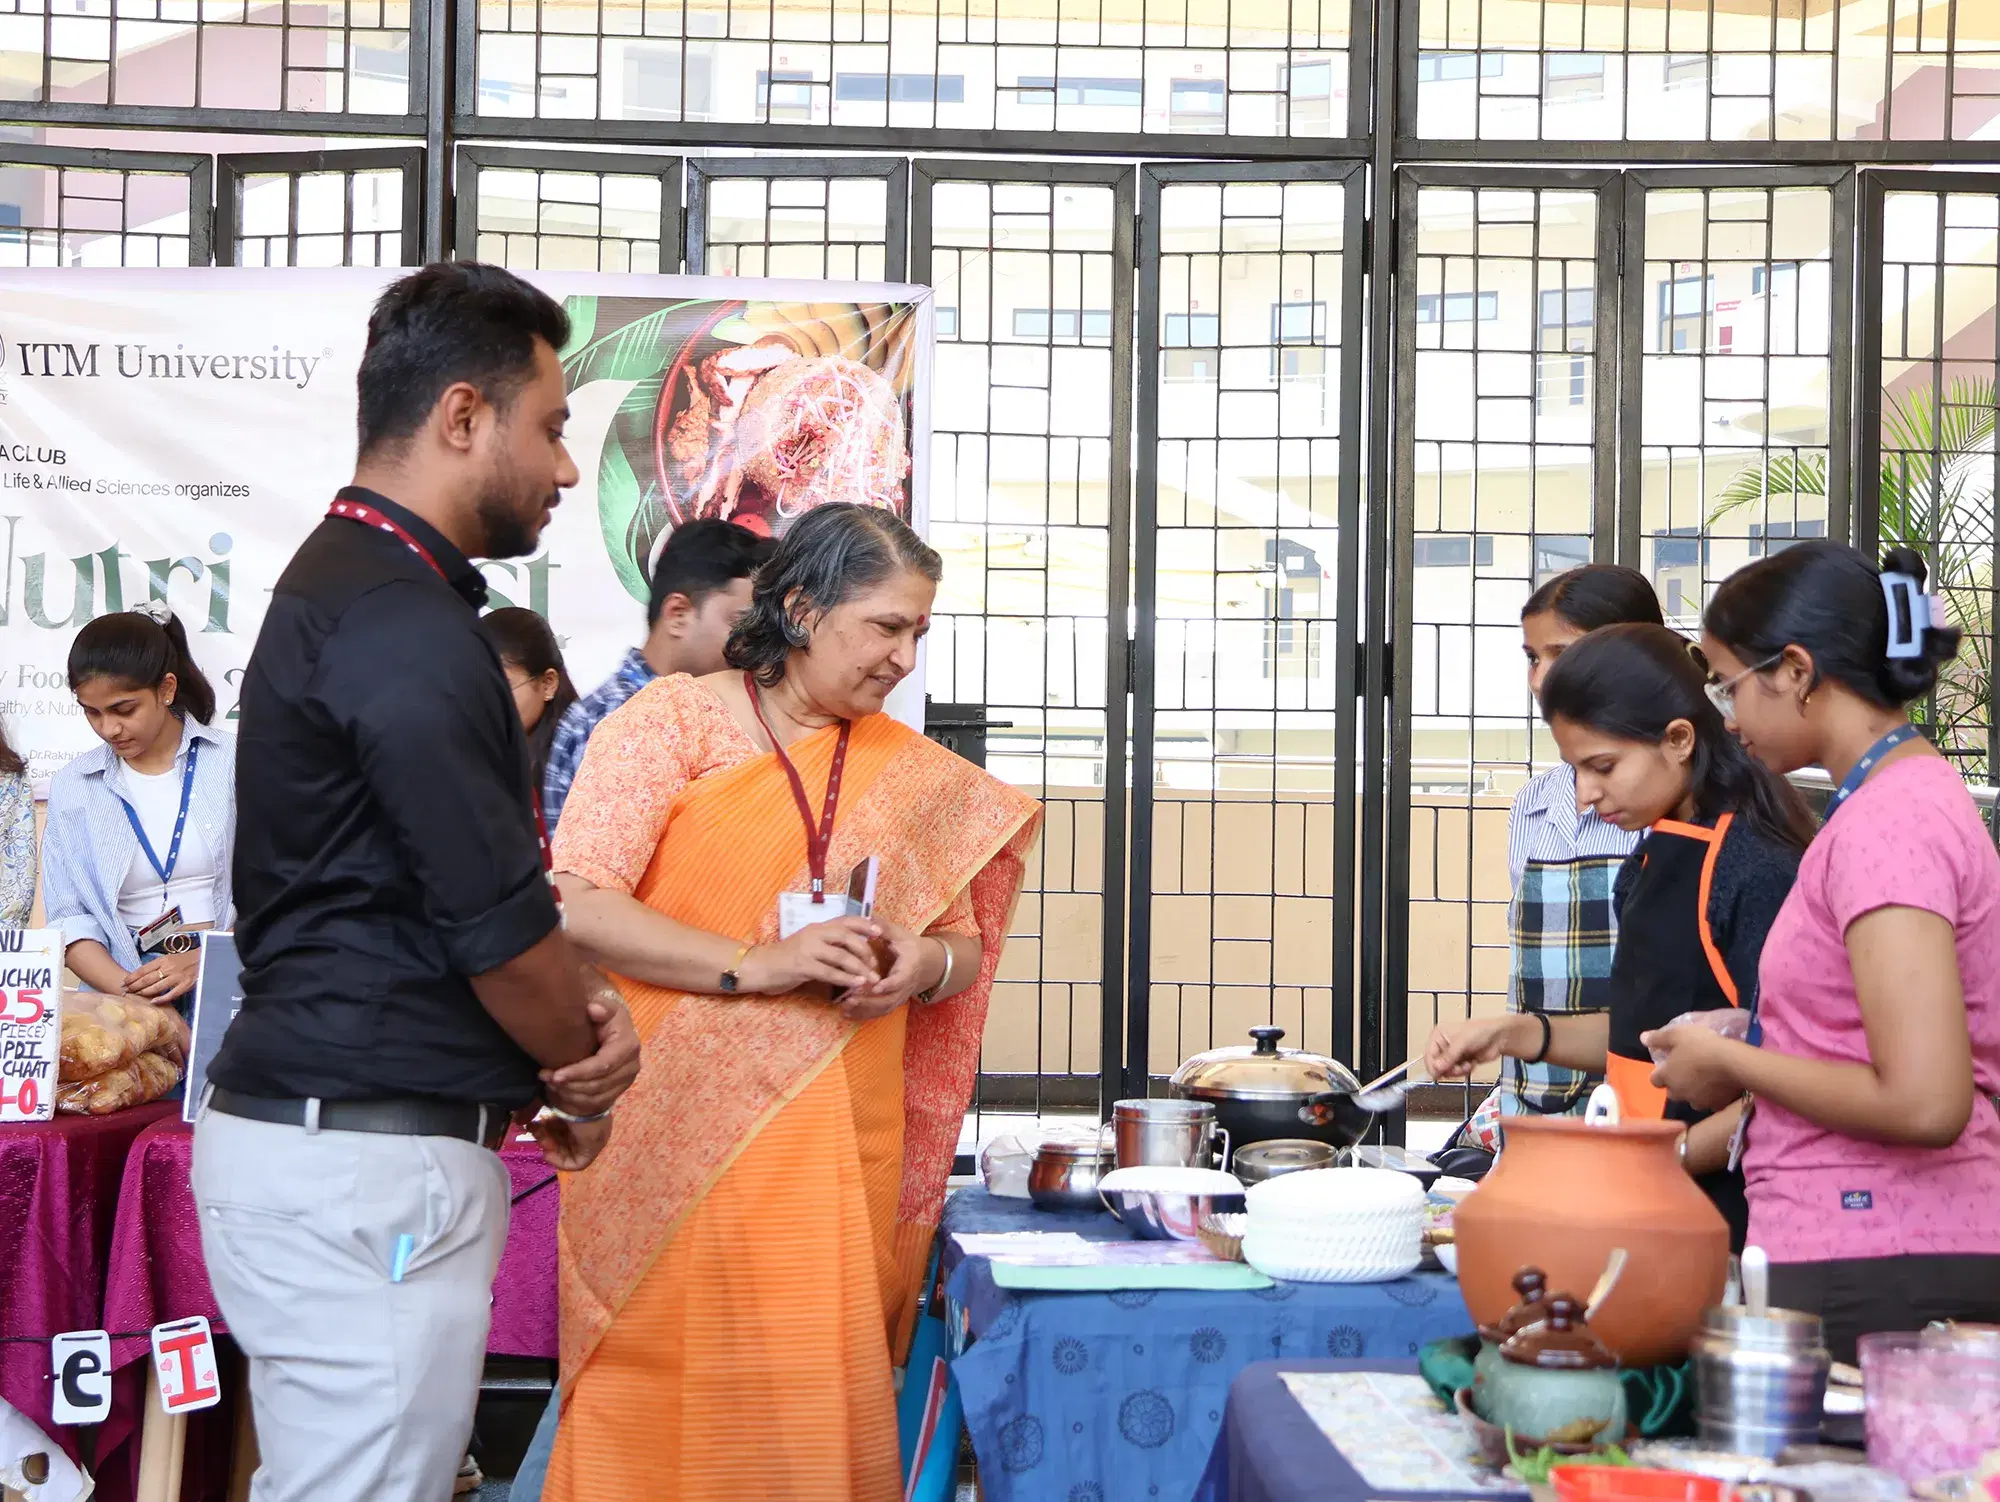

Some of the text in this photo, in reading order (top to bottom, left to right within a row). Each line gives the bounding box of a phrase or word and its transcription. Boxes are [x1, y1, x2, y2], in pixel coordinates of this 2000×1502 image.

[17, 342, 100, 377] ITM
[3, 472, 251, 501] Life & Allied Sciences organizes
[17, 663, 71, 689] Foo
